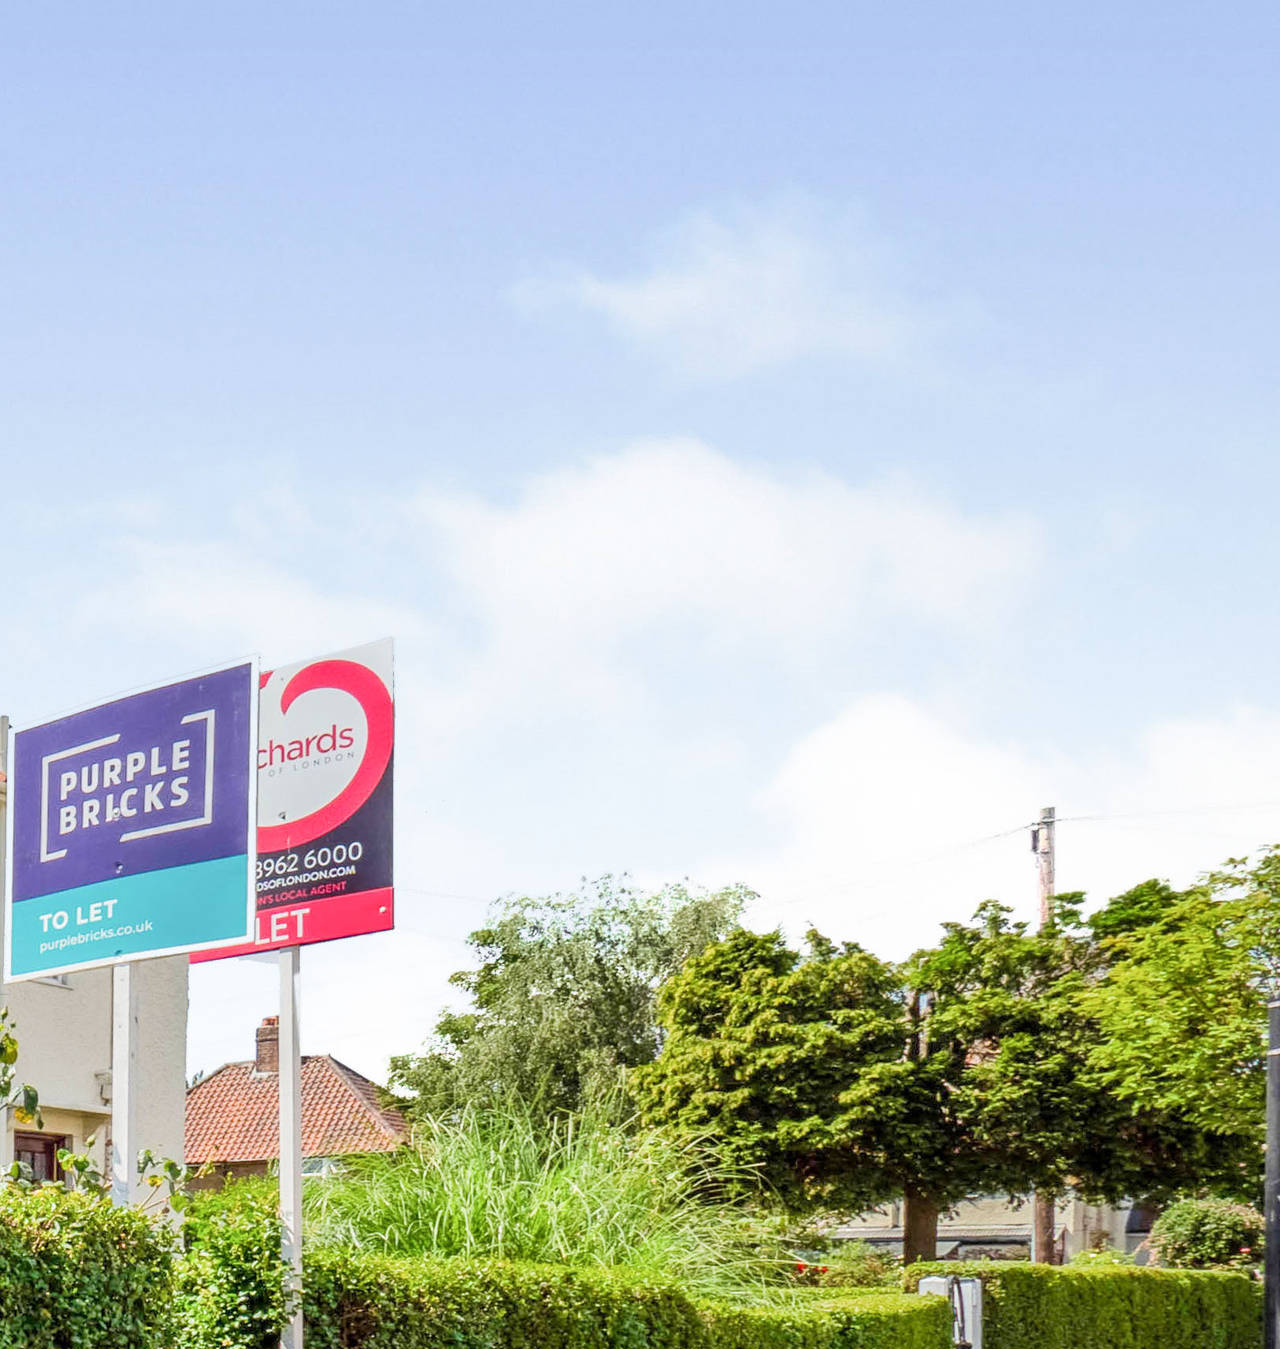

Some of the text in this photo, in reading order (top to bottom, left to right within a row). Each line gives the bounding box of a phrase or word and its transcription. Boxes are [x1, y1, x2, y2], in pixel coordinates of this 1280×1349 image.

[60, 739, 190, 801] PURPLE
[293, 752, 355, 772] LONDON
[59, 776, 189, 836] BRICKS
[303, 841, 363, 869] 6000
[275, 889, 308, 903] LOCAL
[310, 881, 347, 896] AGENT
[39, 899, 118, 933] TO LET
[255, 908, 311, 945] LET
[40, 920, 153, 954] purplebricks.co.uk
